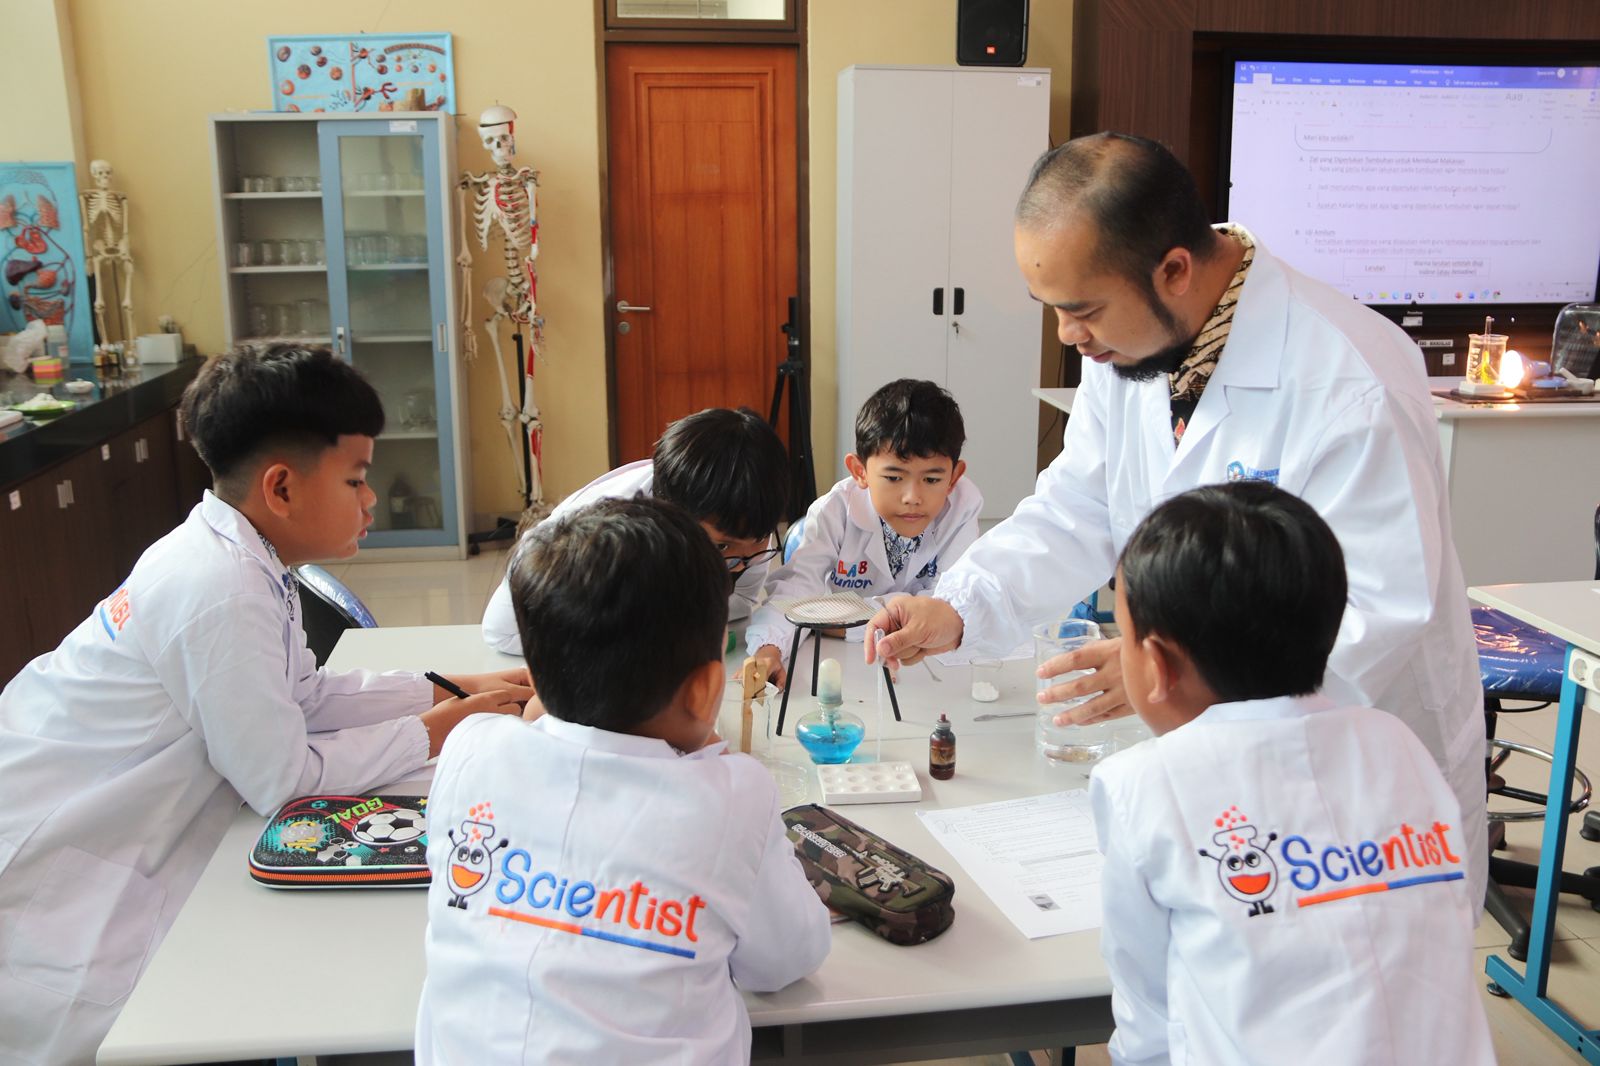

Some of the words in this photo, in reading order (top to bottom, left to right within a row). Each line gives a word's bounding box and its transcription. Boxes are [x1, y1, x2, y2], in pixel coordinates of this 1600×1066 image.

[837, 560, 868, 578] LAB
[324, 797, 384, 824] GOAL
[1280, 821, 1461, 891] Scientist
[495, 848, 707, 943] Scientist
